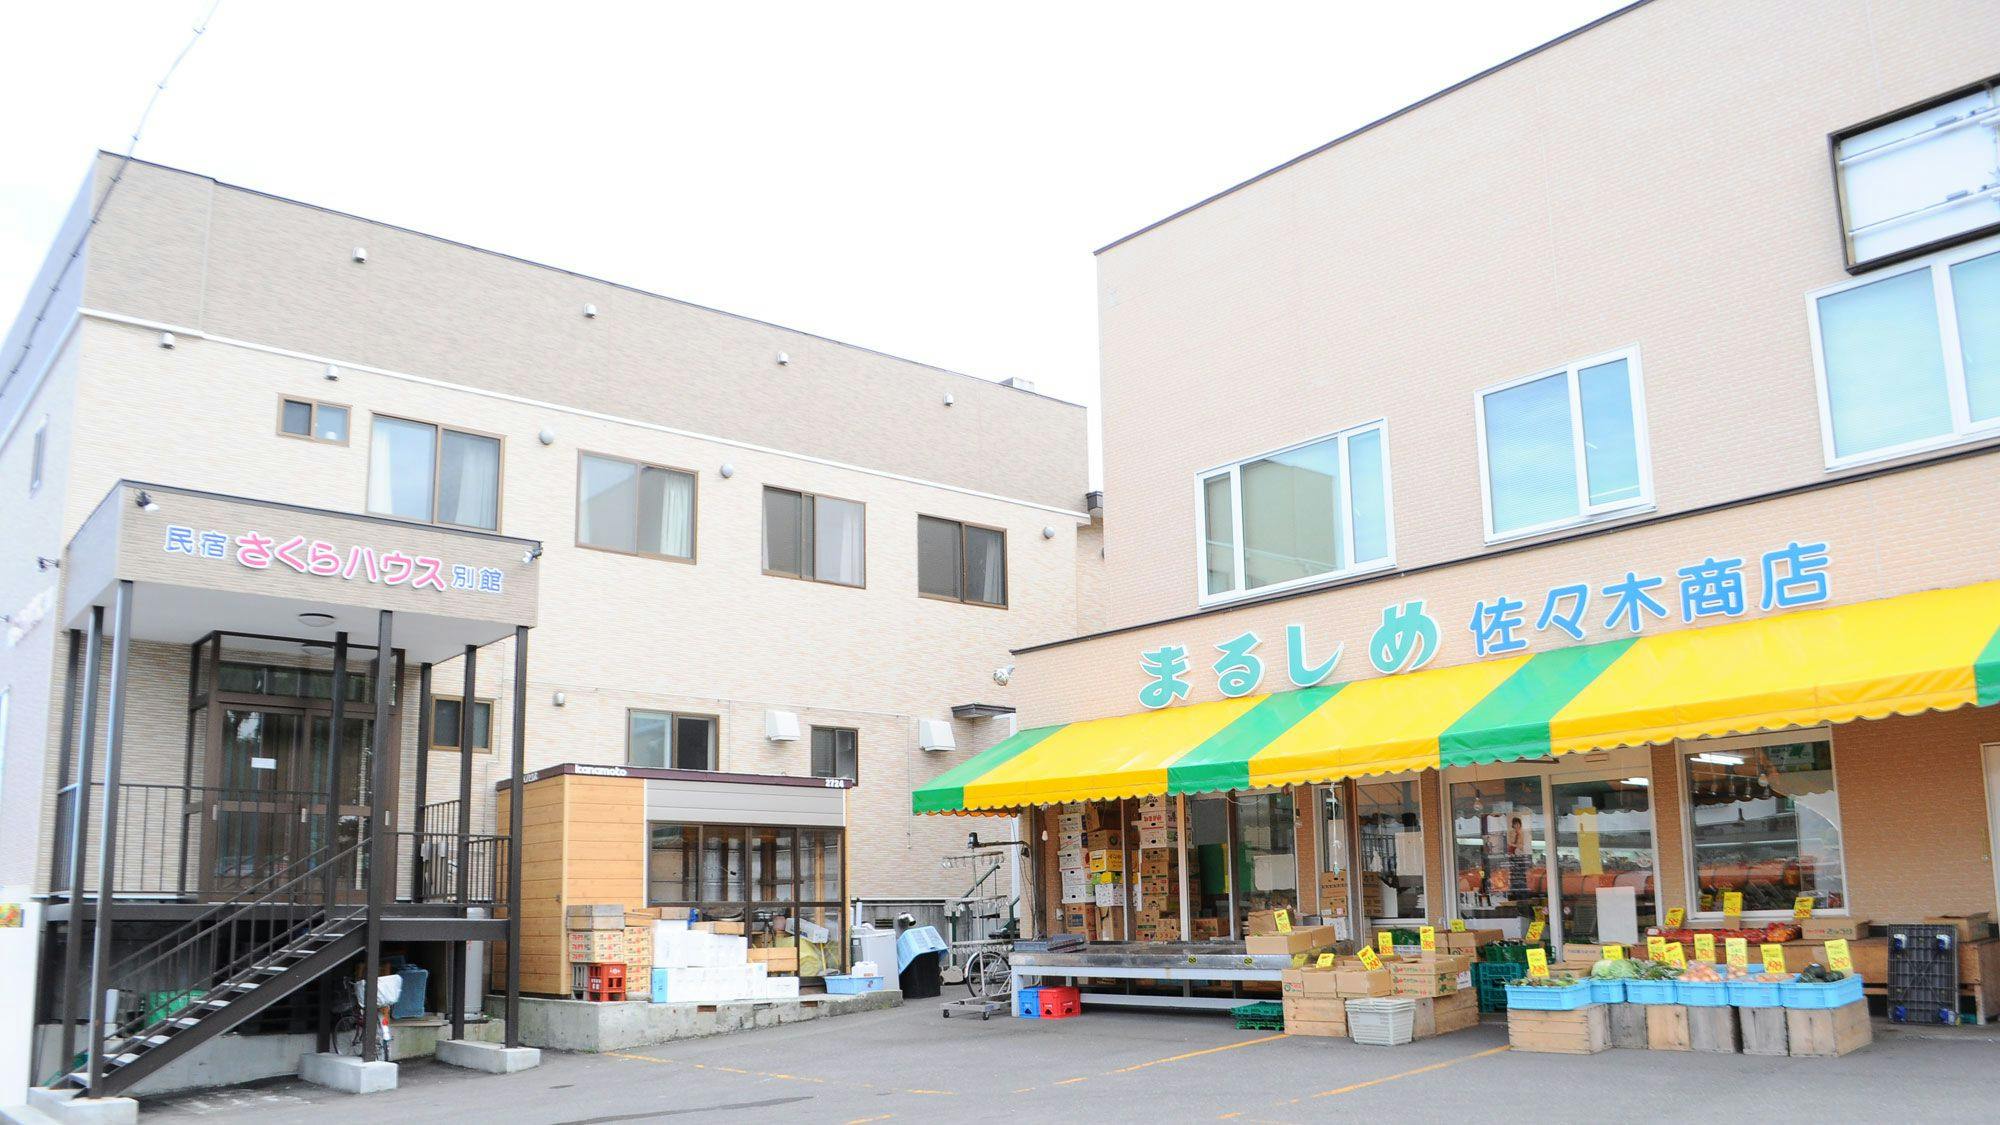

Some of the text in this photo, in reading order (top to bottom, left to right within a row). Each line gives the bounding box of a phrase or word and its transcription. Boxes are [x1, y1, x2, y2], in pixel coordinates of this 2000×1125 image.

[164, 525, 503, 593] 民宿 さくらハウス 別館
[1138, 541, 1832, 708] まるしめ 佐々木商店
[575, 764, 628, 776] kanamoto
